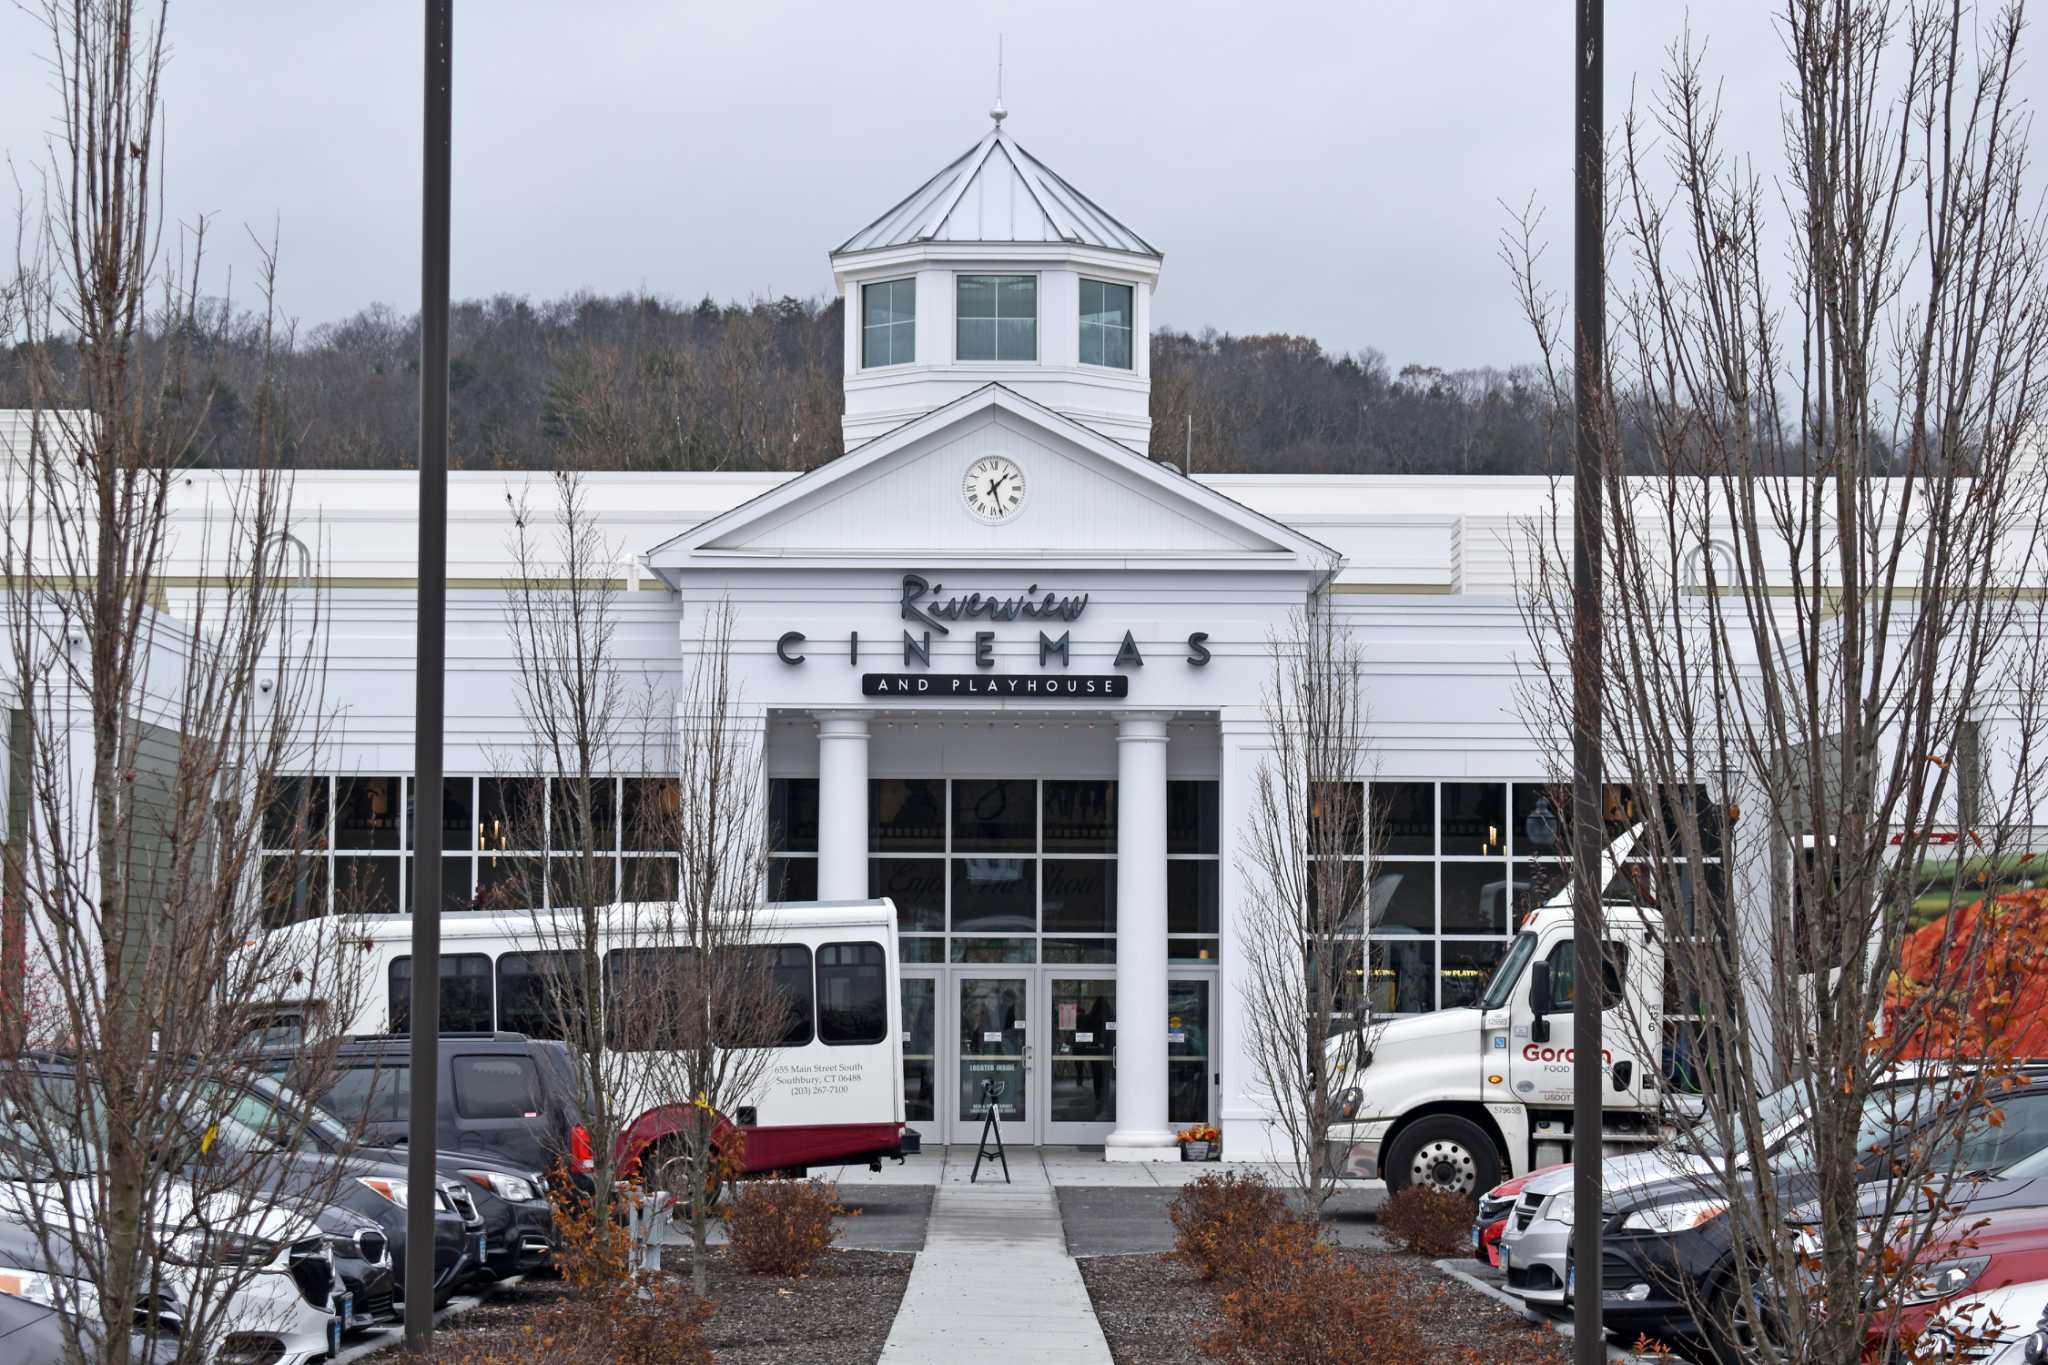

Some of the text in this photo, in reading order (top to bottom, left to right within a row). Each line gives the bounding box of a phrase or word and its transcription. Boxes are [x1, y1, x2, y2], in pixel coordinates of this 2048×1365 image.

[901, 574, 1089, 634] Riverview
[776, 629, 1212, 667] CINEMAS
[878, 679, 1113, 693] AND PLAYHOUSE
[1648, 1022, 1656, 1032] 6
[1522, 1043, 1611, 1065] Gorn
[791, 1064, 812, 1073] Main
[814, 1063, 837, 1072] Street
[839, 1062, 863, 1071] South
[1544, 1065, 1570, 1073] FOOD
[823, 1074, 837, 1083] CT
[791, 1086, 811, 1096] (203)
